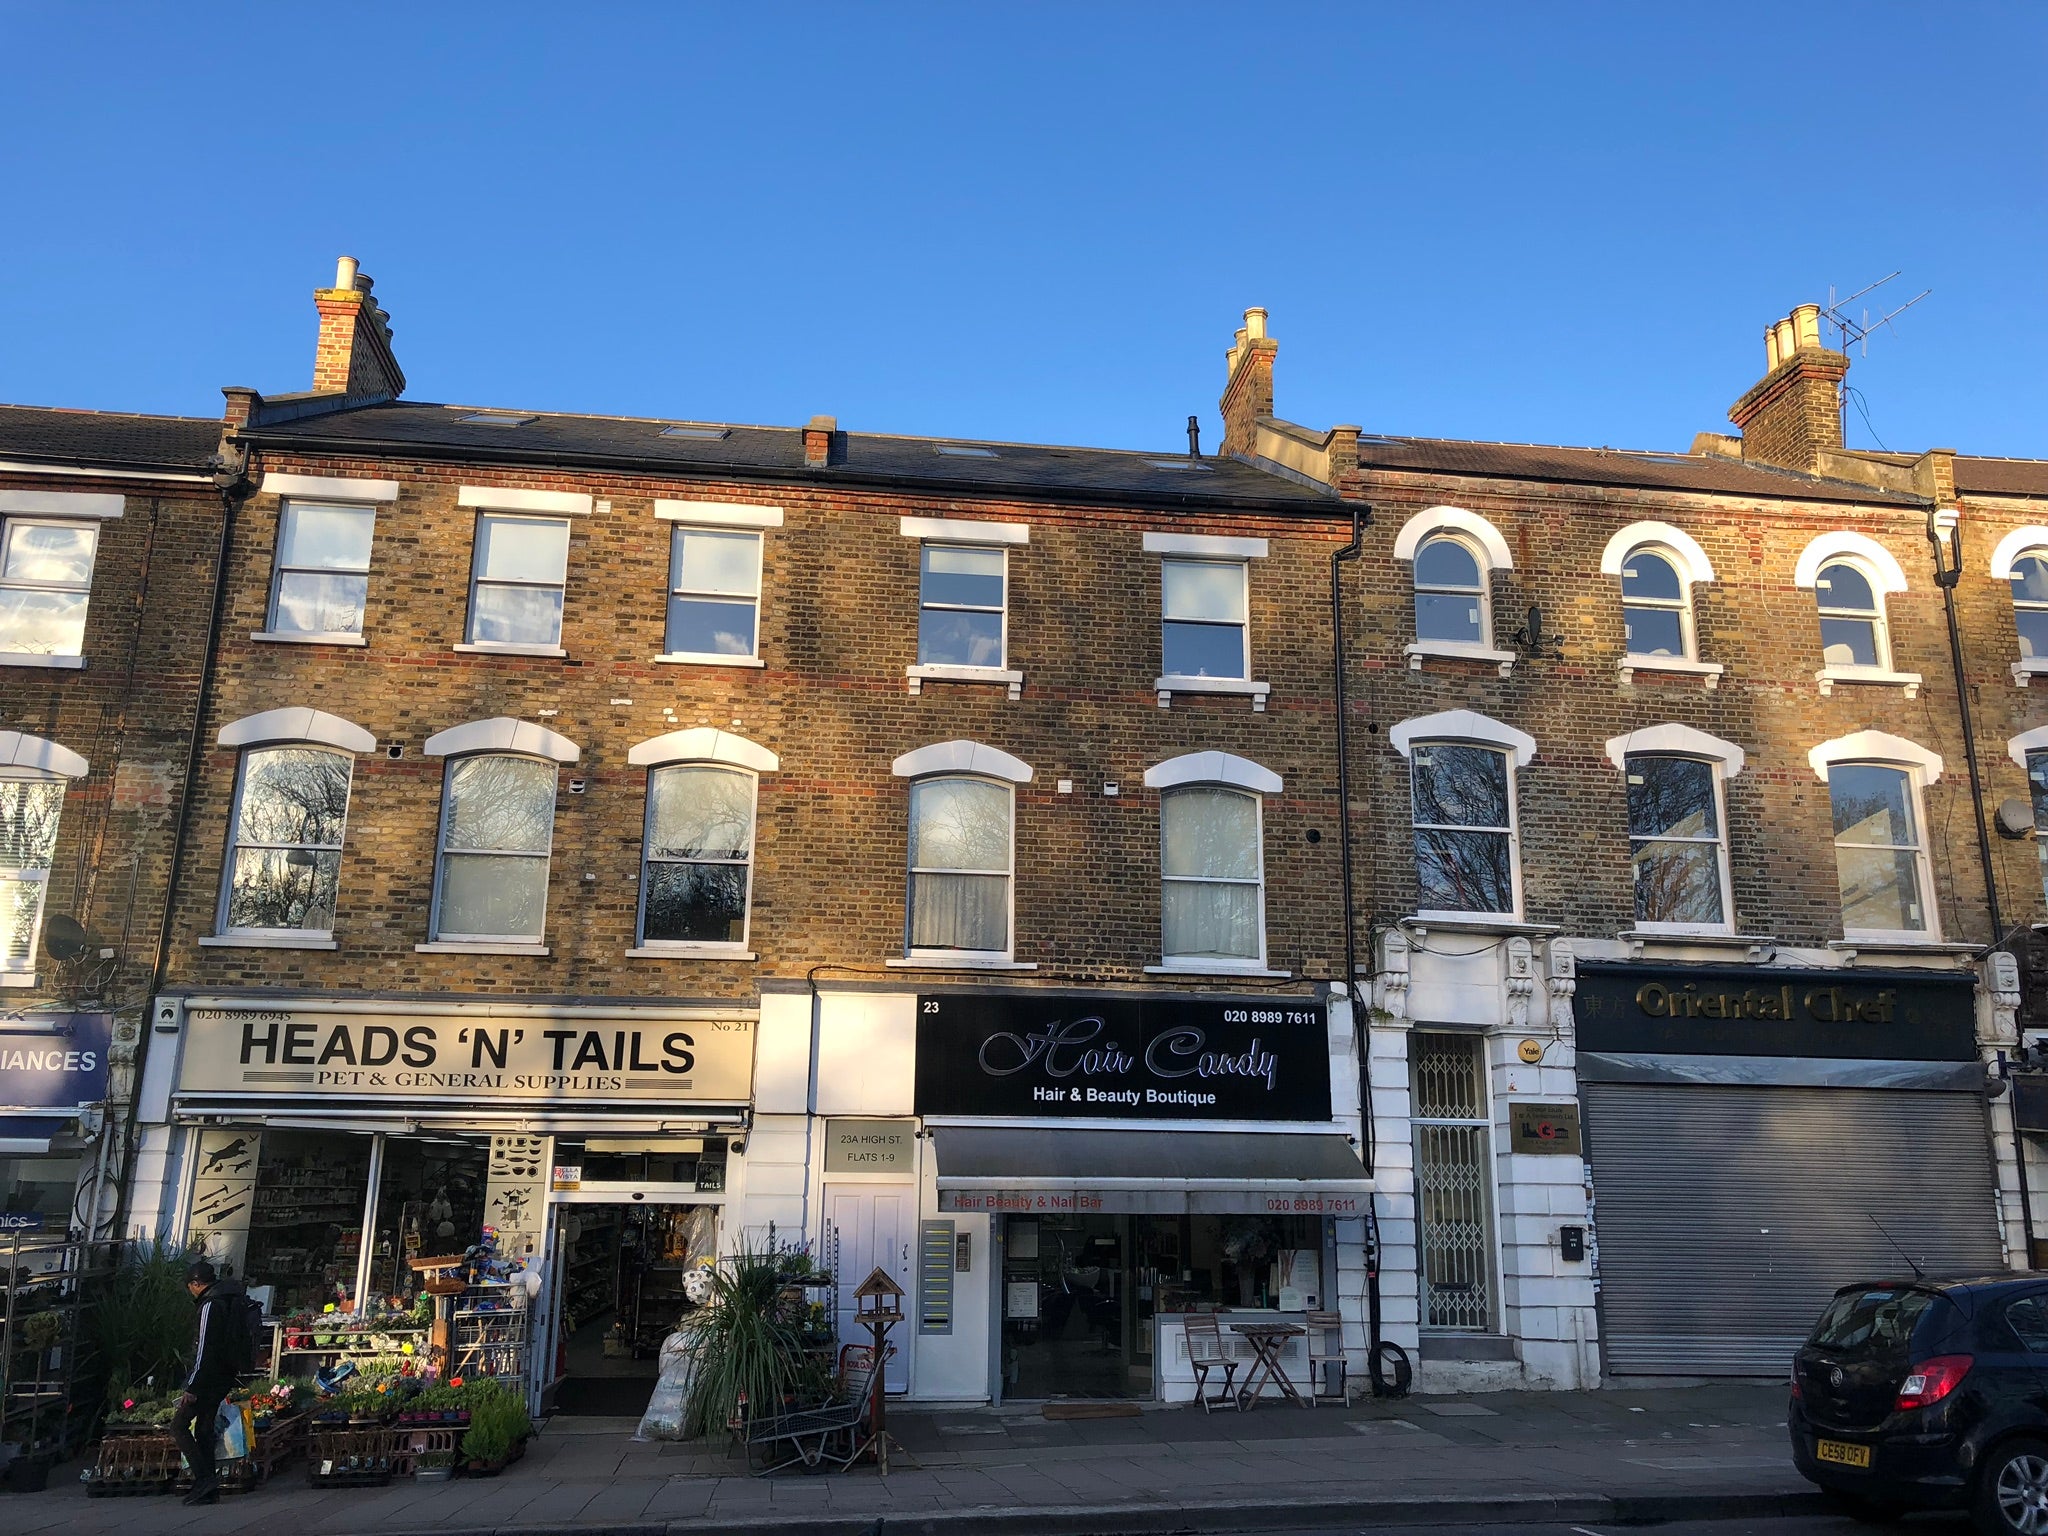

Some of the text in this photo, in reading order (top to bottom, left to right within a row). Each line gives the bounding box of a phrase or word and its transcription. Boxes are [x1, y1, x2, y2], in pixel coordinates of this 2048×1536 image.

[923, 1001, 940, 1013] 23
[1636, 982, 1794, 1021] Oriental
[1804, 987, 1897, 1023] Chef
[197, 1010, 292, 1021] 020 8989 6945
[1224, 1010, 1316, 1024] 020 8989 7611
[711, 1021, 748, 1031] No 21
[239, 1024, 437, 1068] HEADS
[543, 1030, 695, 1074] TAILS
[979, 1016, 1280, 1091] Hair Candy
[1523, 1047, 1540, 1056] Yale
[0, 1050, 97, 1072] IANCES
[317, 1071, 622, 1091] PET & GENERAL SUPPLIES
[1033, 1087, 1217, 1107] Hair & Beauty Boutique
[841, 1135, 903, 1145] 23A HIGH ST.
[847, 1153, 895, 1162] FLATS 1-9
[954, 1195, 1104, 1211] Hair Beauty & Nail Bar
[1267, 1199, 1355, 1211] 020 8989 7611
[1821, 1443, 1845, 1461] CE58
